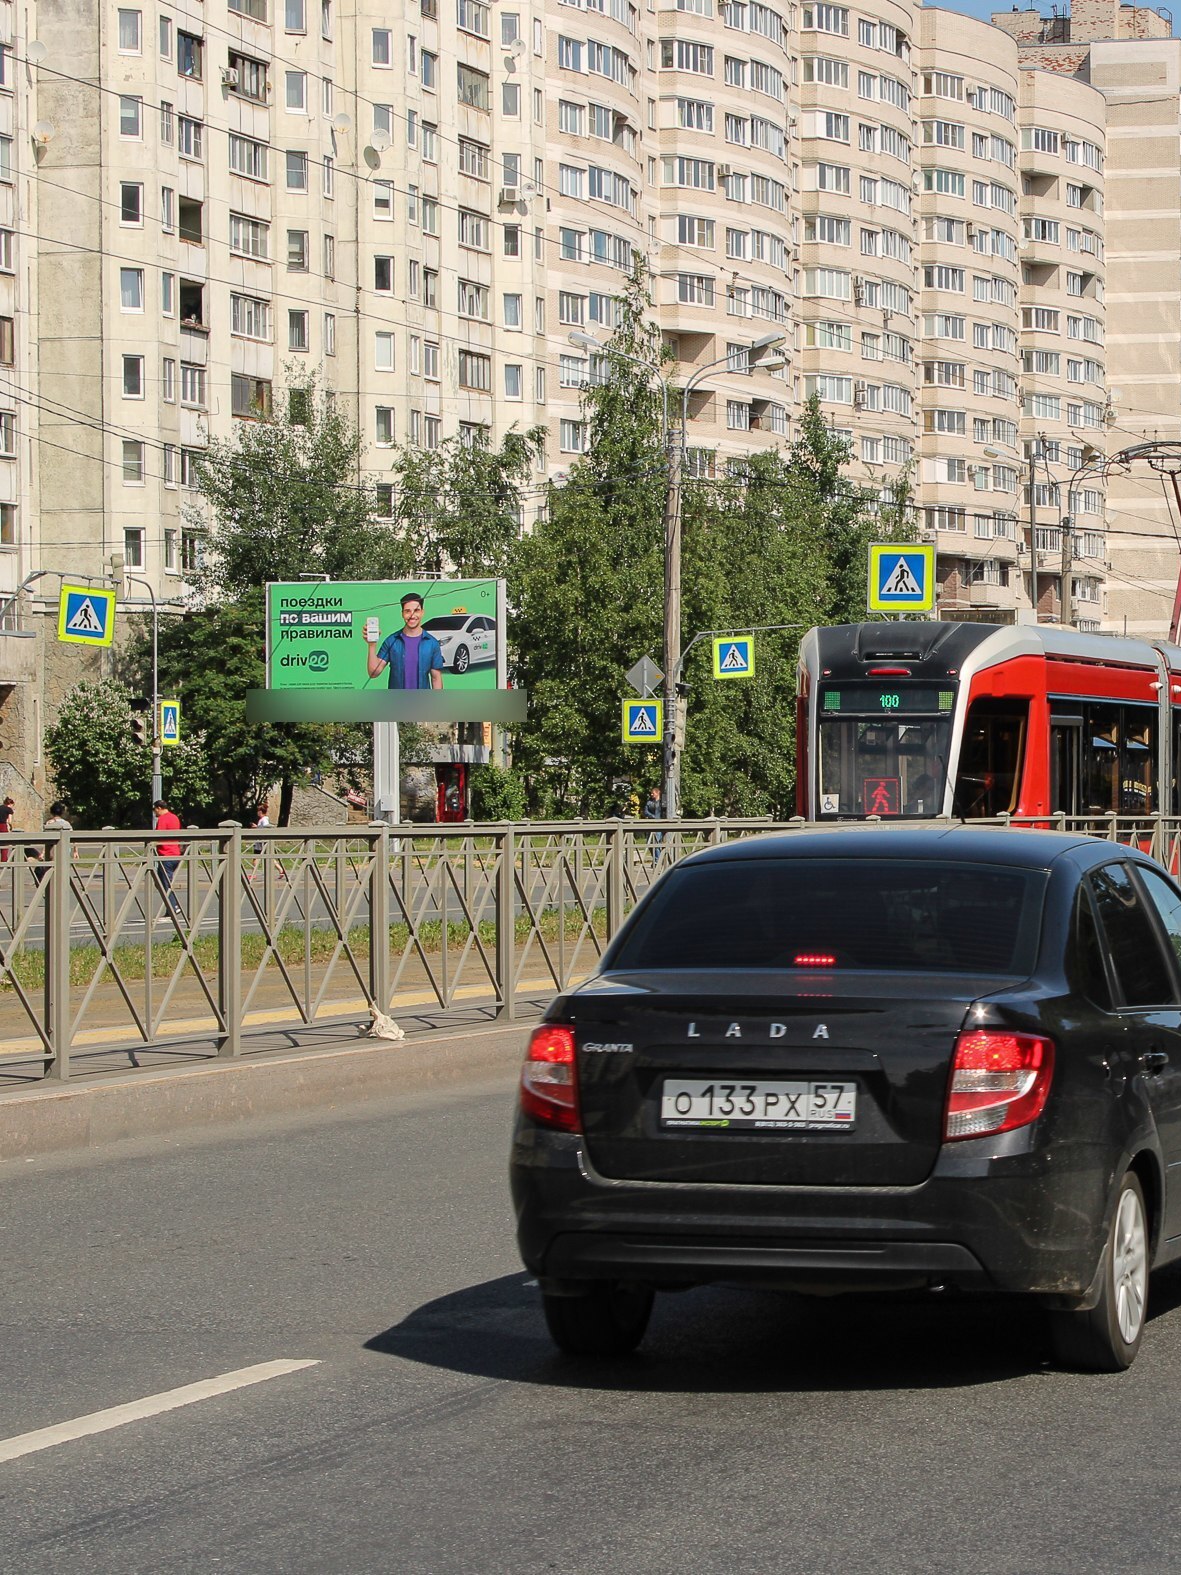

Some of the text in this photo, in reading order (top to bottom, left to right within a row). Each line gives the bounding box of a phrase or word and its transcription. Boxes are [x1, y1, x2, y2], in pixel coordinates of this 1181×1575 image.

[280, 597, 343, 609] поездки
[280, 612, 352, 624] по вашим
[281, 629, 353, 642] правилам
[880, 694, 900, 708] 100
[687, 1022, 830, 1039] LADA
[813, 1084, 844, 1109] 57
[810, 1109, 834, 1119] RUS
